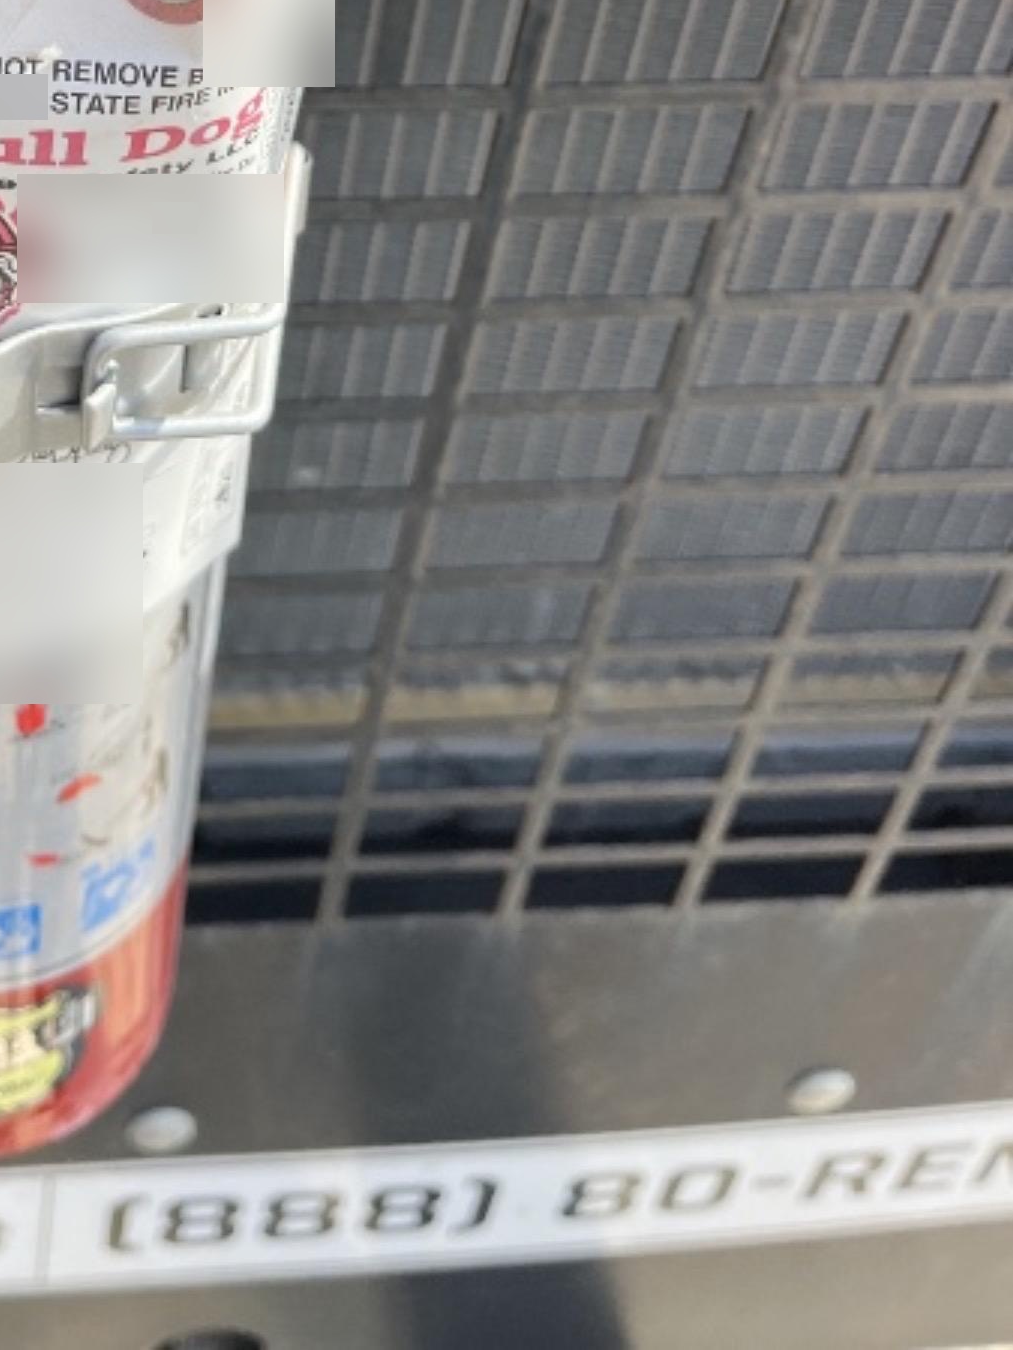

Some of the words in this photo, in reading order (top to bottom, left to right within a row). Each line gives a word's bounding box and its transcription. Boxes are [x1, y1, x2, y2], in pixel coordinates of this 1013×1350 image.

[51, 59, 179, 88] REMOVE
[49, 90, 141, 116] STATE
[151, 86, 212, 115] FIRE
[119, 86, 268, 163] Dog
[106, 1176, 497, 1254] (888)
